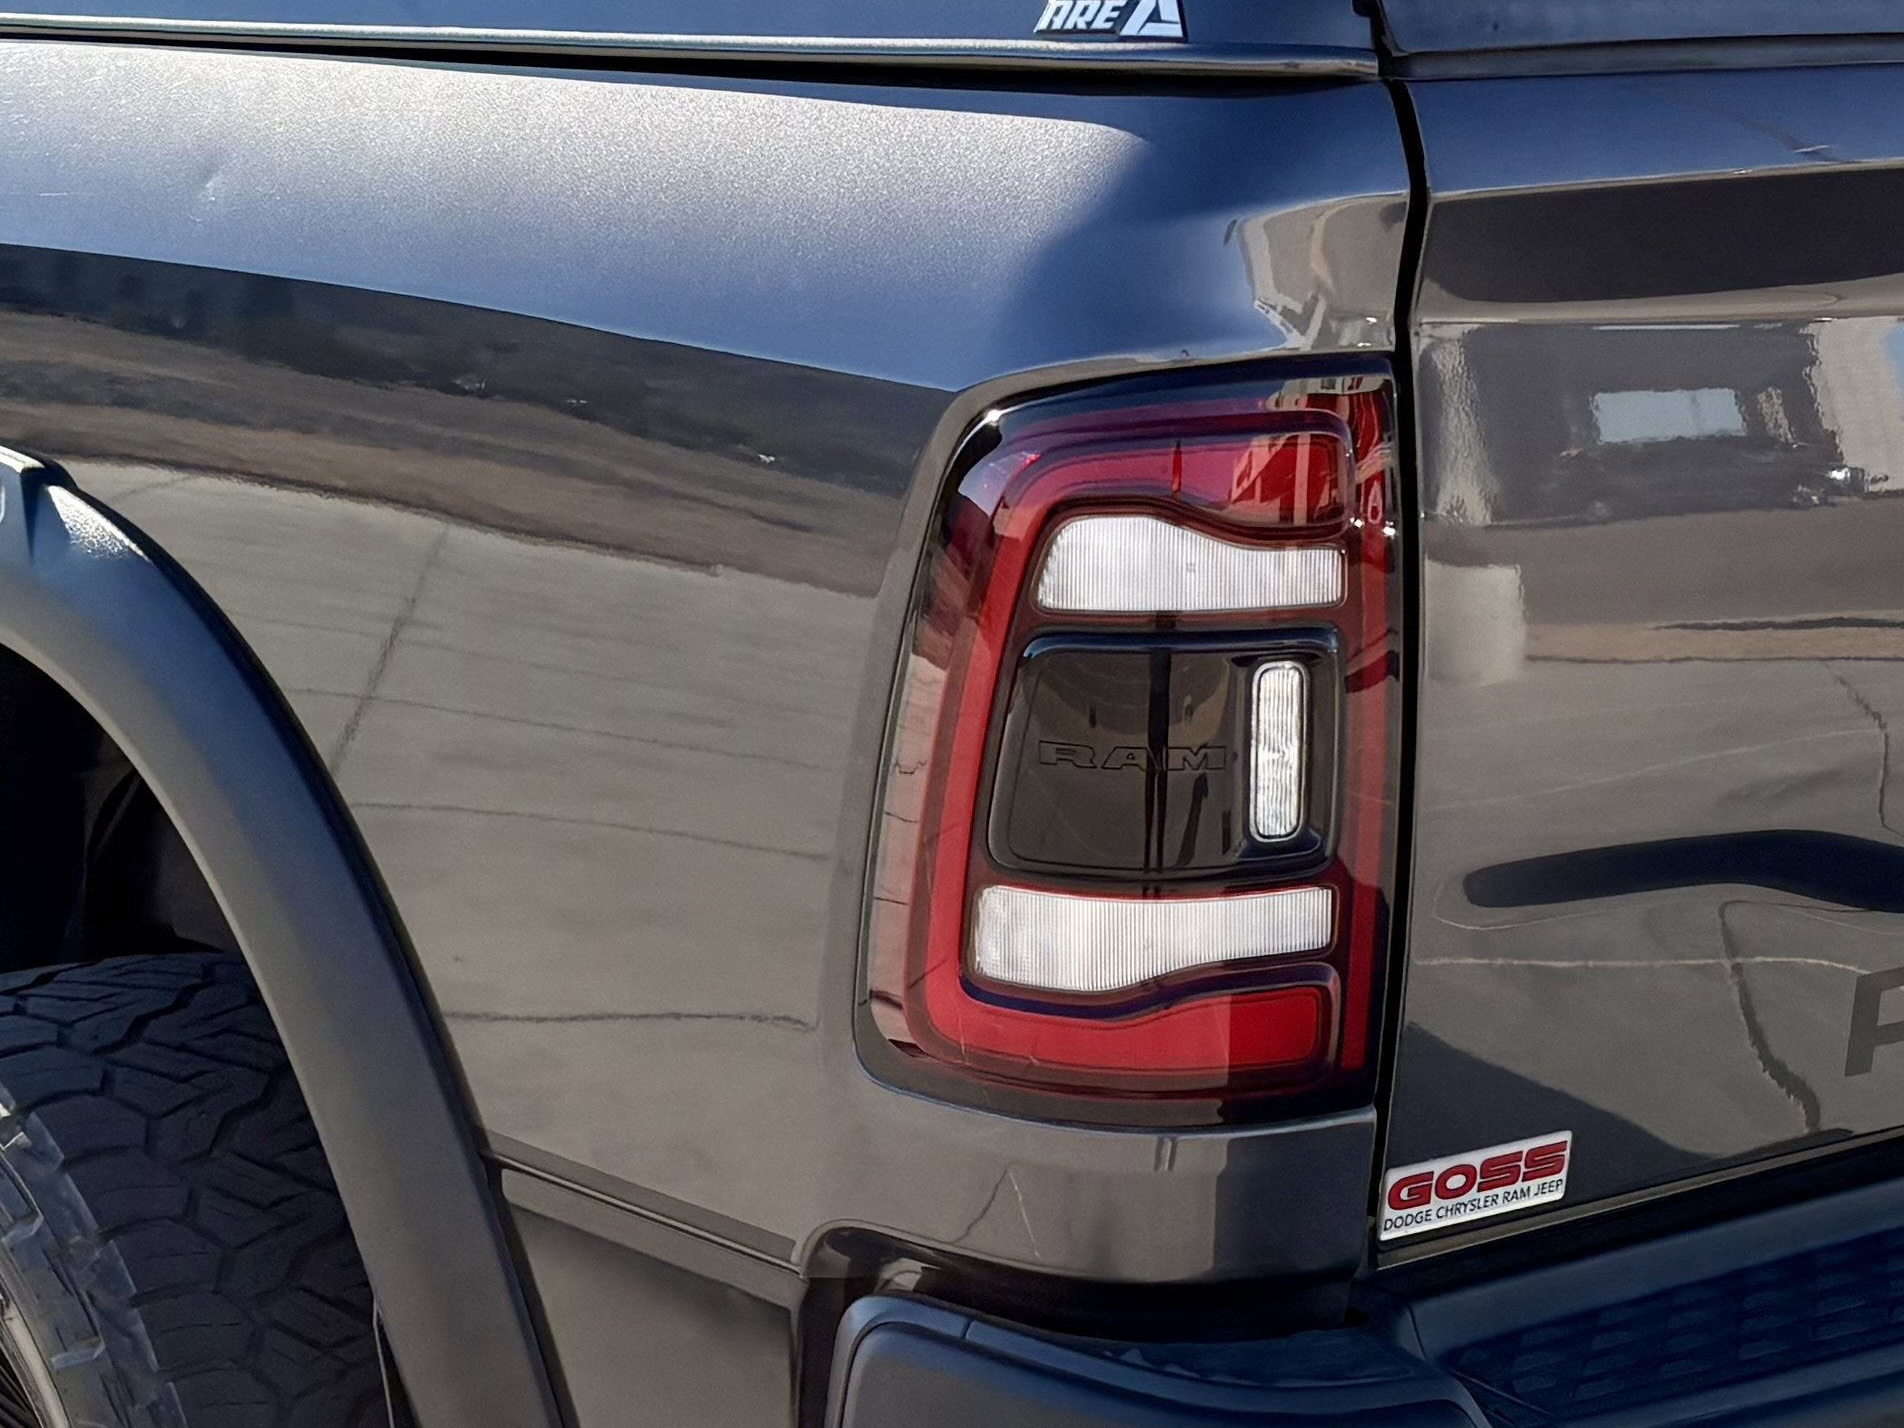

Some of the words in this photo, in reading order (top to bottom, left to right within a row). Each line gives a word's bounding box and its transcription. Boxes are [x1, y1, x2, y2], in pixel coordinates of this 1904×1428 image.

[1039, 739, 1227, 772] RAM
[1387, 1140, 1568, 1211] GOSS
[1383, 1208, 1433, 1232] DODGE
[1436, 1194, 1499, 1219] CHRYSLER
[1502, 1185, 1531, 1204] RAM
[1533, 1178, 1564, 1197] JEEP
